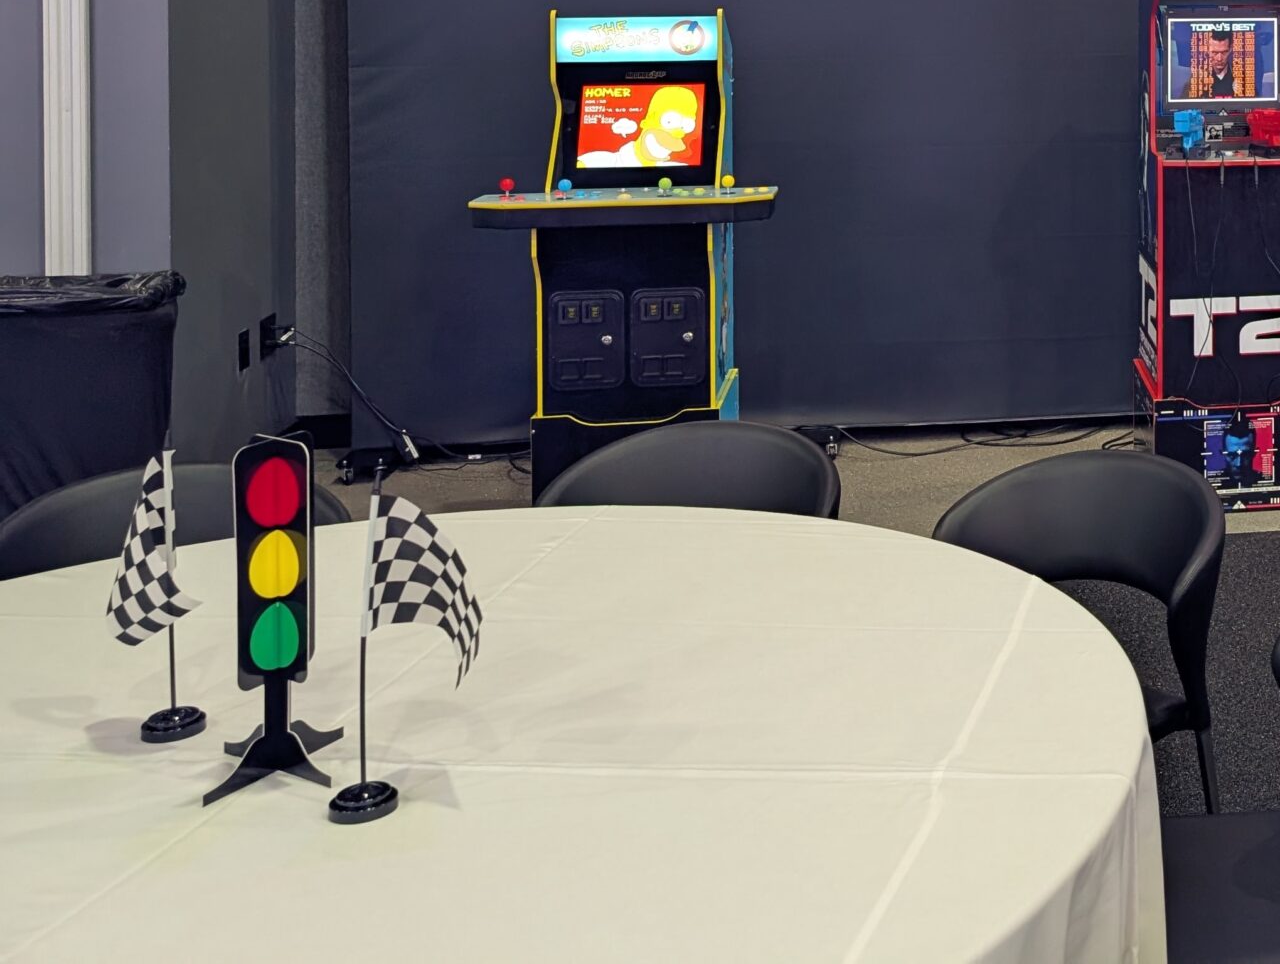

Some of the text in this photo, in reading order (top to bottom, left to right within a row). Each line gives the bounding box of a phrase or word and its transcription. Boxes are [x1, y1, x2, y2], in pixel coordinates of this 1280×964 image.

[589, 20, 628, 36] THE
[1190, 22, 1256, 32] TODAY'S BEST
[585, 87, 631, 98] HOMER
